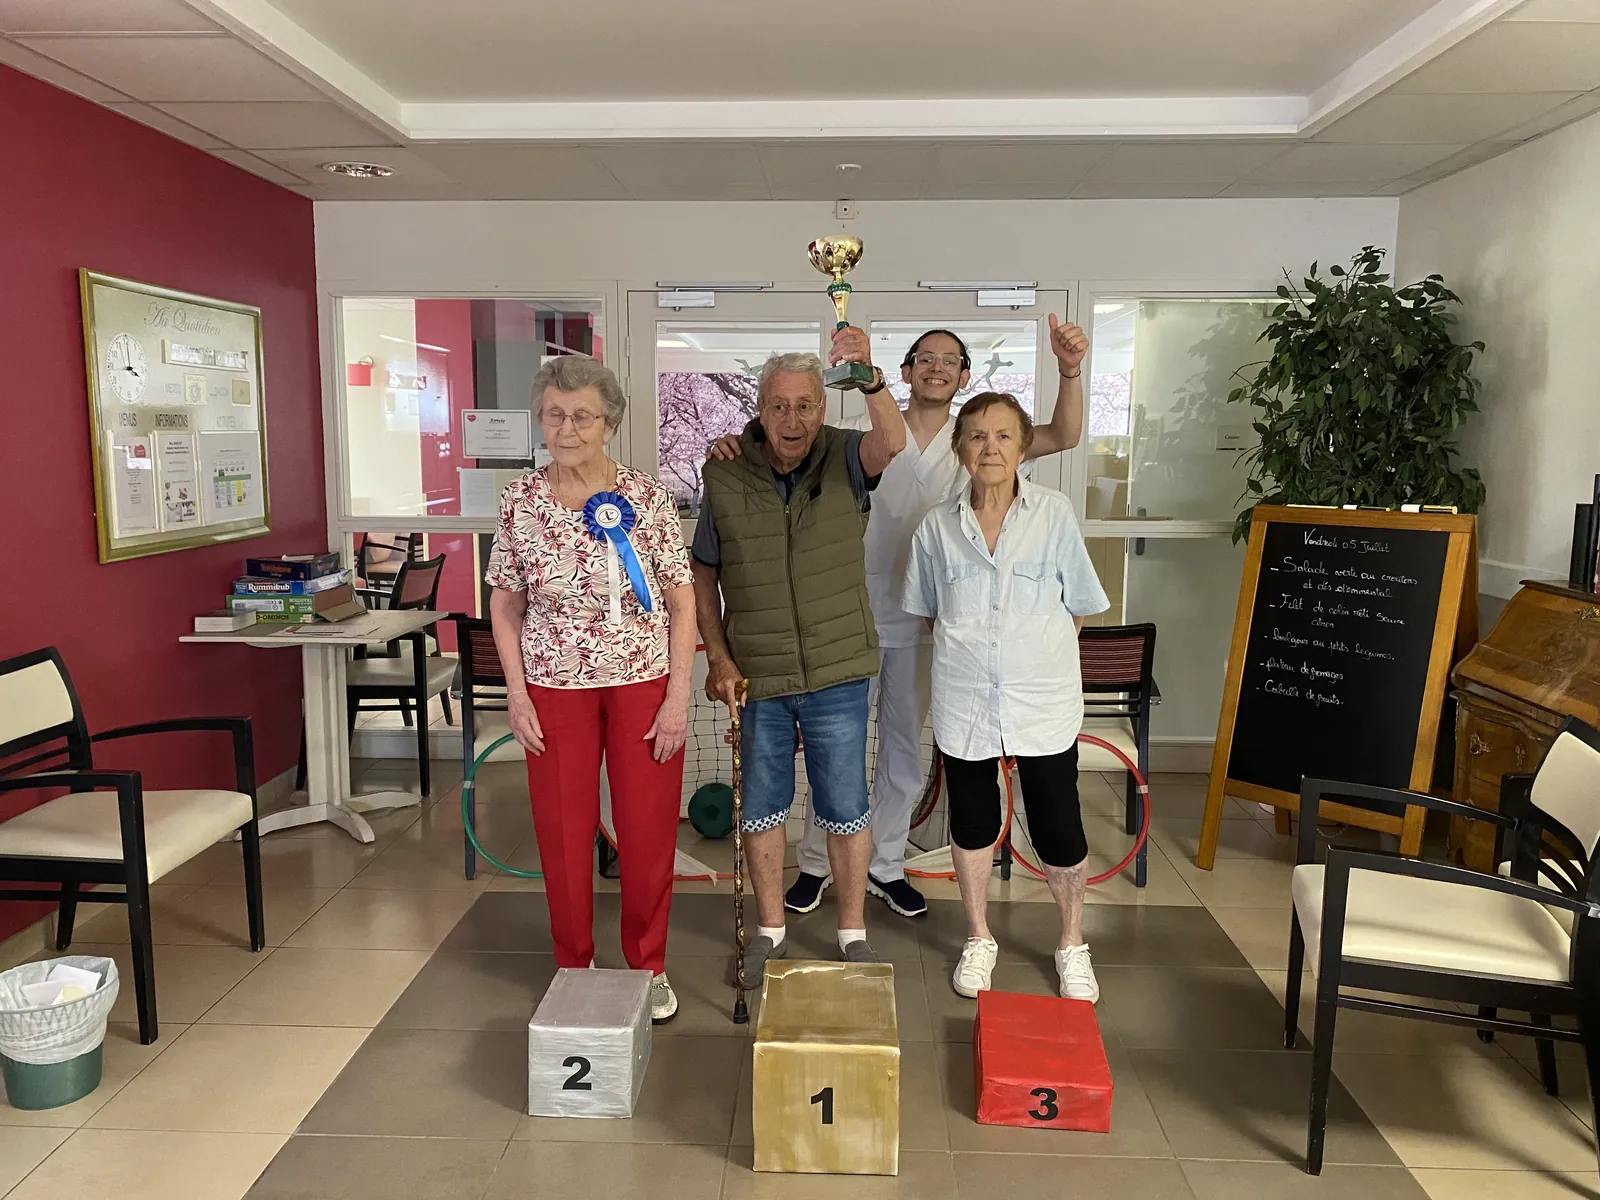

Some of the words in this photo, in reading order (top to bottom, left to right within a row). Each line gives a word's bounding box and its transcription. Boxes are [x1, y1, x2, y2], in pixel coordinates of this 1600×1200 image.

[143, 301, 170, 327] Au
[173, 307, 221, 336] Quotidien
[154, 414, 189, 428] INFORMATIONS
[1304, 528, 1338, 548] Vendredi
[1342, 539, 1357, 550] 05
[1358, 541, 1390, 554] Juillet
[1283, 556, 1329, 576] Salade
[1334, 566, 1358, 578] verte
[1360, 572, 1376, 580] au
[248, 583, 290, 593] Rummikub
[1303, 579, 1313, 589] et
[1317, 580, 1332, 591] dés
[1280, 593, 1304, 611] Filet
[1313, 600, 1324, 613] de
[1328, 604, 1350, 615] colin
[1311, 617, 1335, 629] citron
[1273, 627, 1309, 648] boulgour
[1312, 639, 1325, 647] au
[1328, 640, 1350, 654] petits
[1300, 661, 1310, 675] de
[1309, 667, 1344, 684] fromages
[1264, 679, 1300, 698] Corbeille
[1305, 688, 1315, 700] de
[562, 1055, 592, 1091] 2
[810, 1087, 834, 1125] 1
[1027, 1087, 1059, 1121] 3
